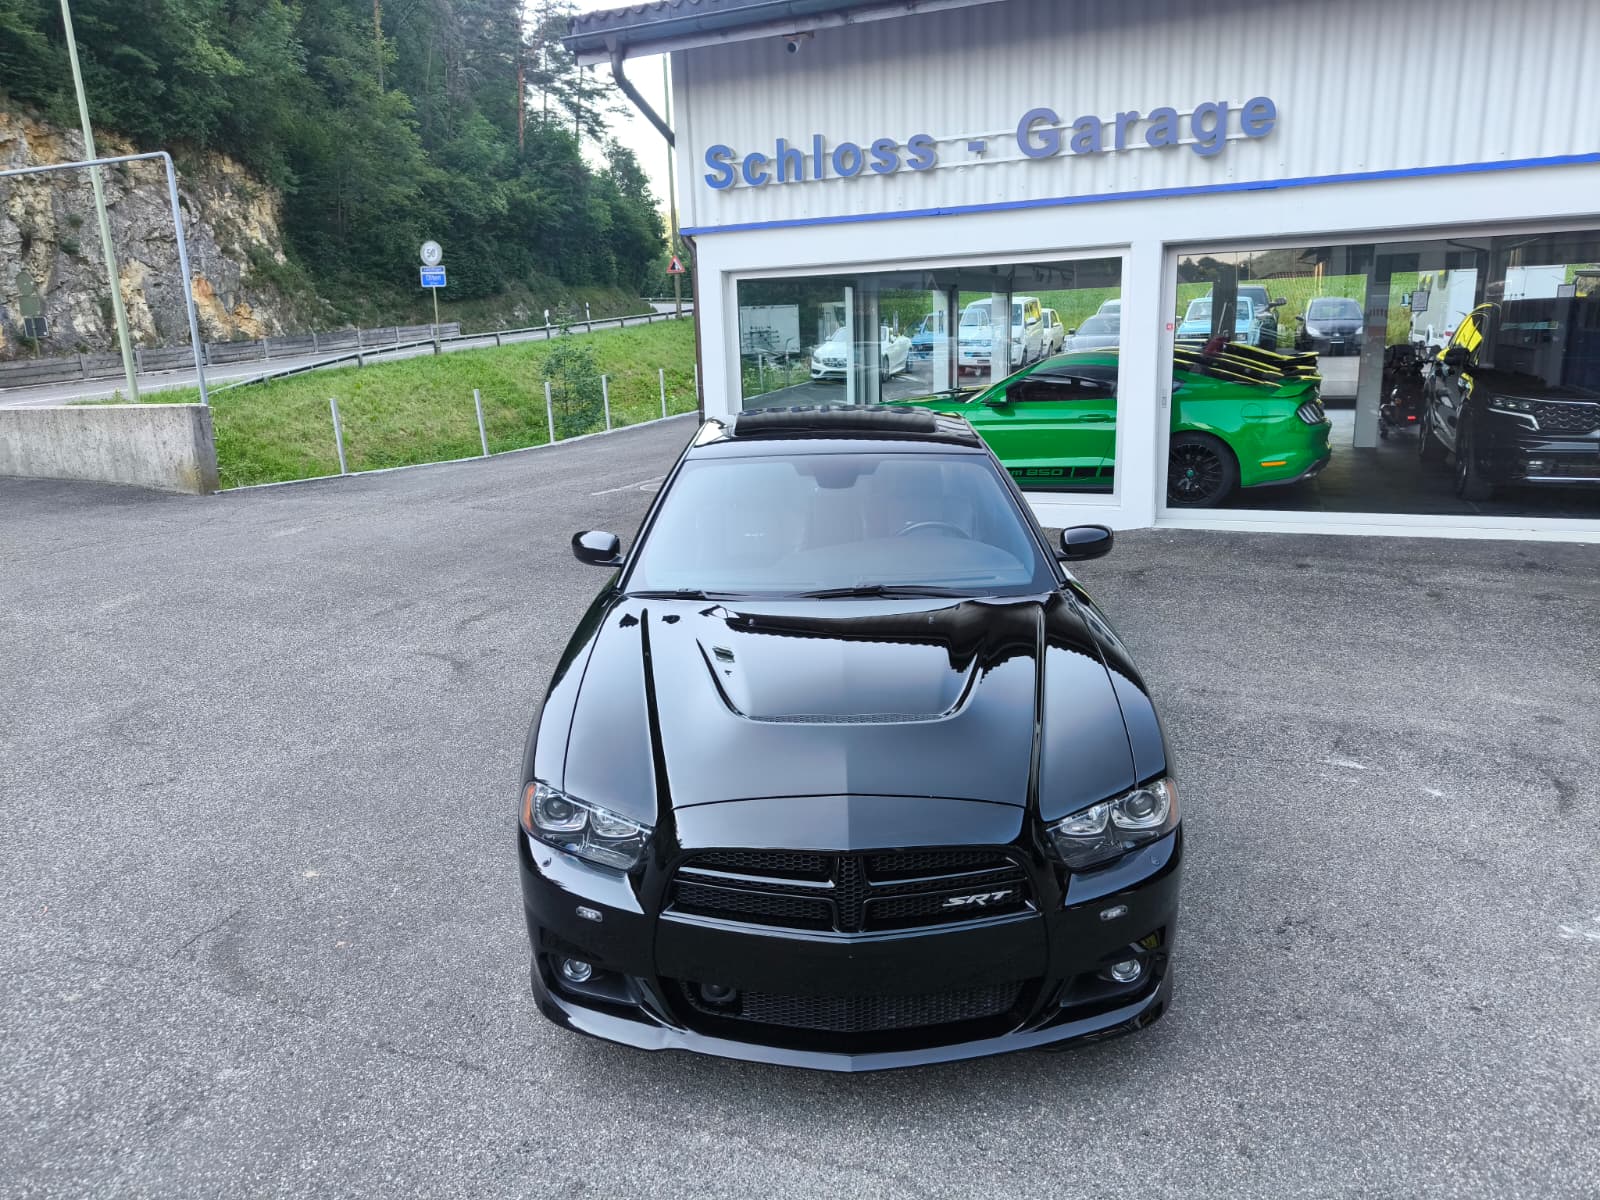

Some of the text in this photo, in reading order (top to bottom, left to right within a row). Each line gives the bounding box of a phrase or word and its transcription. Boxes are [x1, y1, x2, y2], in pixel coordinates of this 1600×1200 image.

[704, 134, 937, 190] Schloss
[1016, 97, 1276, 158] Garage
[942, 889, 1013, 907] SRT
